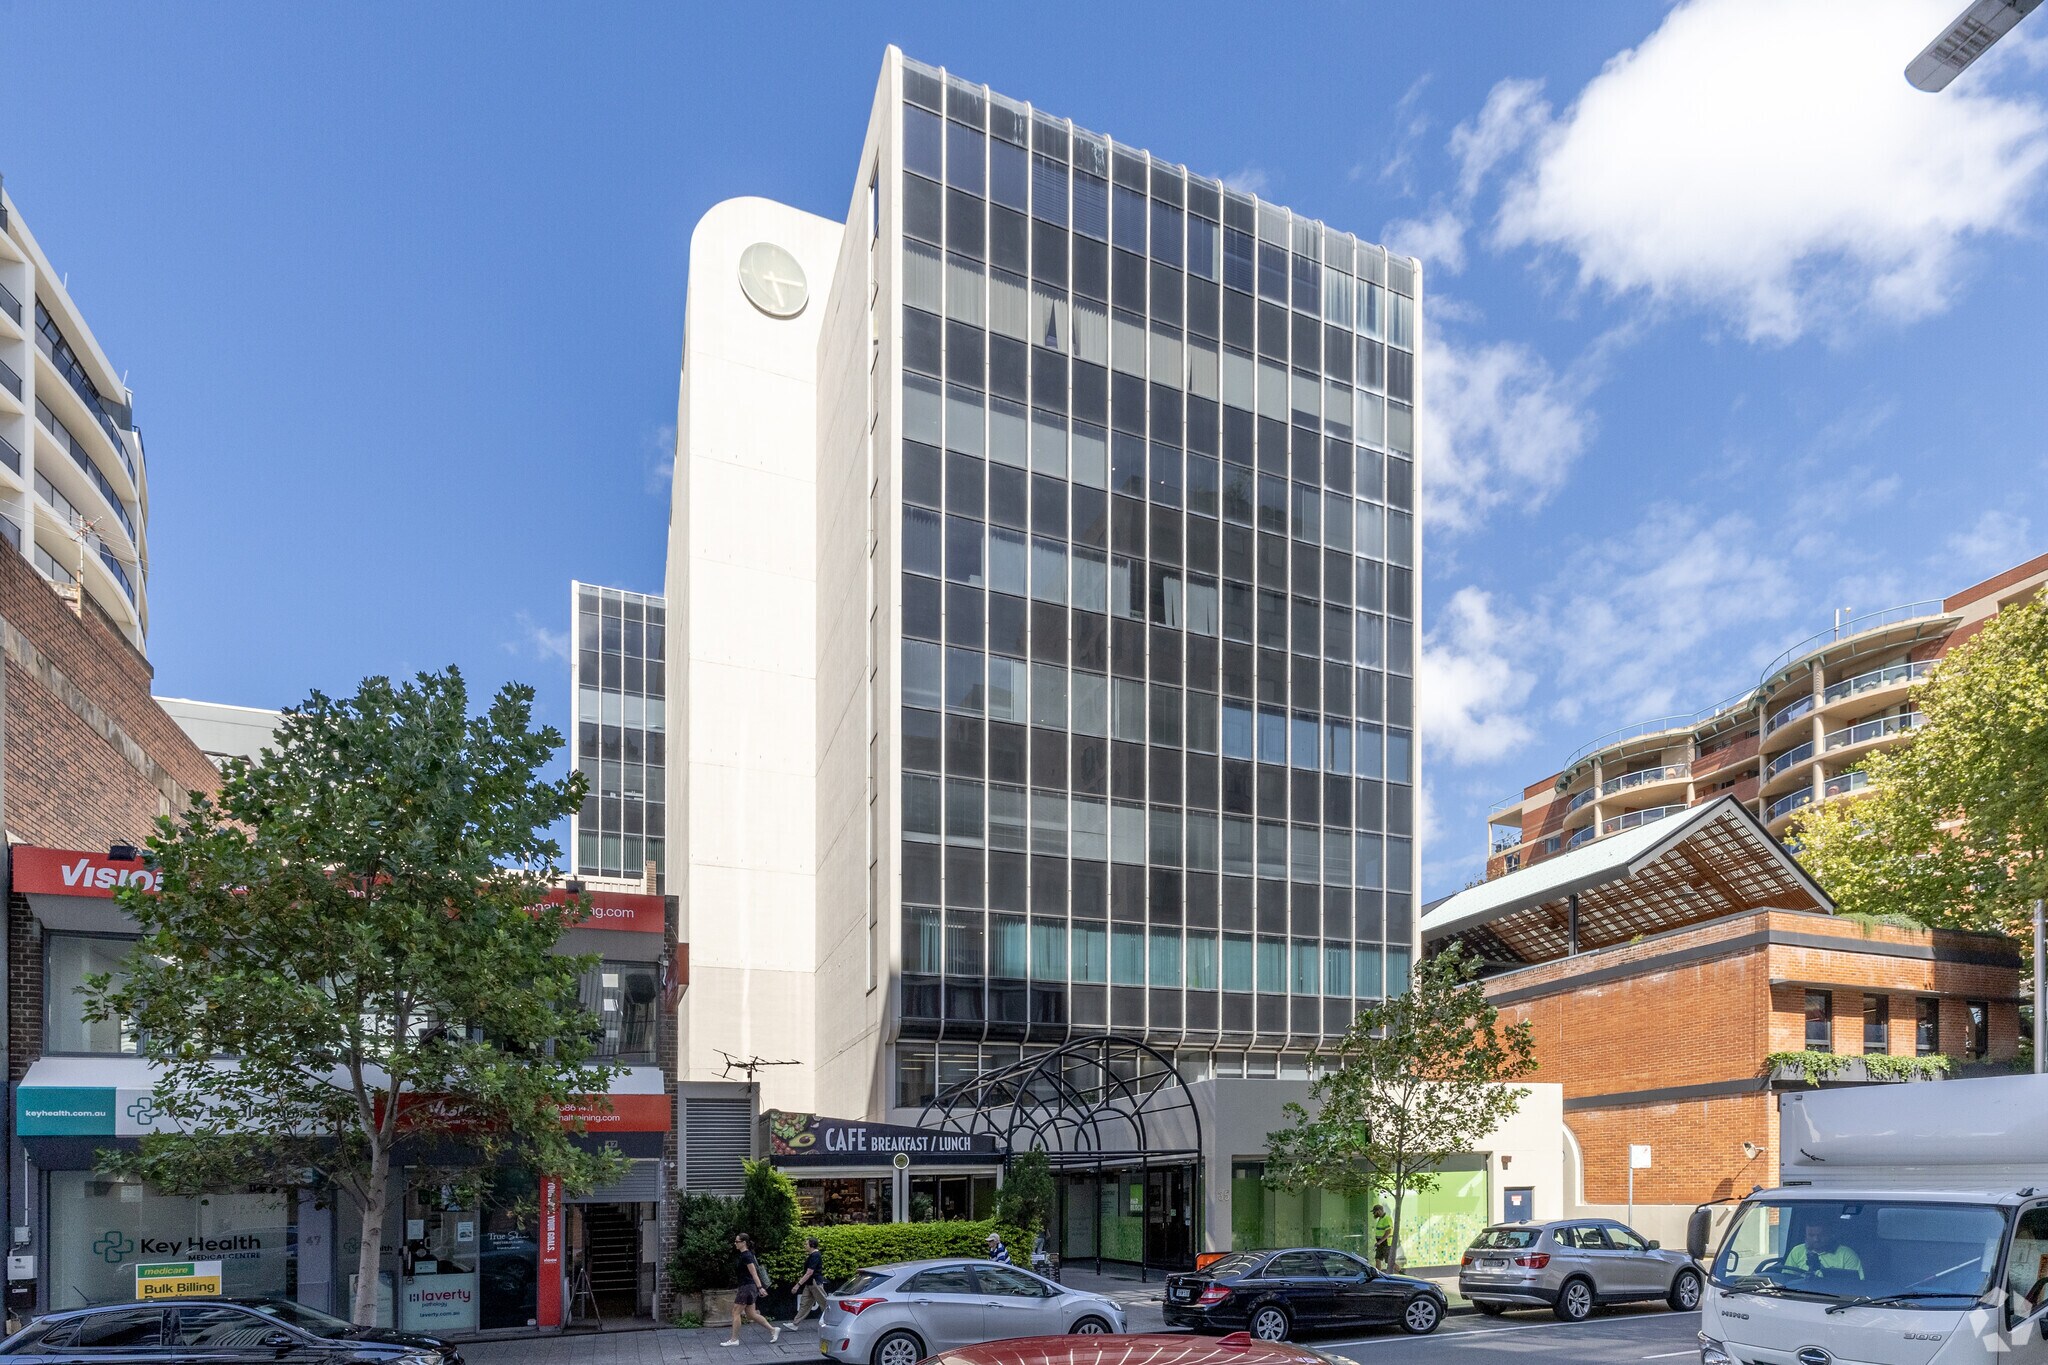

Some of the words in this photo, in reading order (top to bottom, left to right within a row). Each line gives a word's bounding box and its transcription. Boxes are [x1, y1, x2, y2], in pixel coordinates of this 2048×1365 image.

[25, 1109, 106, 1118] keyhealth.com.au
[825, 1127, 867, 1152] CAFE
[871, 1136, 928, 1151] BREAKFAST
[939, 1136, 971, 1151] LUNCH
[547, 1215, 556, 1231] YOUR
[488, 1232, 506, 1241] True
[141, 1238, 182, 1256] Key
[188, 1235, 261, 1252] Health
[188, 1253, 225, 1261] MEDICAL
[227, 1252, 261, 1260] CENTRE
[144, 1266, 189, 1276] medicare
[144, 1284, 173, 1294] Bulk
[177, 1282, 215, 1293] Billing
[421, 1289, 471, 1303] laverty
[421, 1301, 448, 1309] pathology
[1721, 1310, 1750, 1320] HINO
[1903, 1332, 1942, 1342] 300
